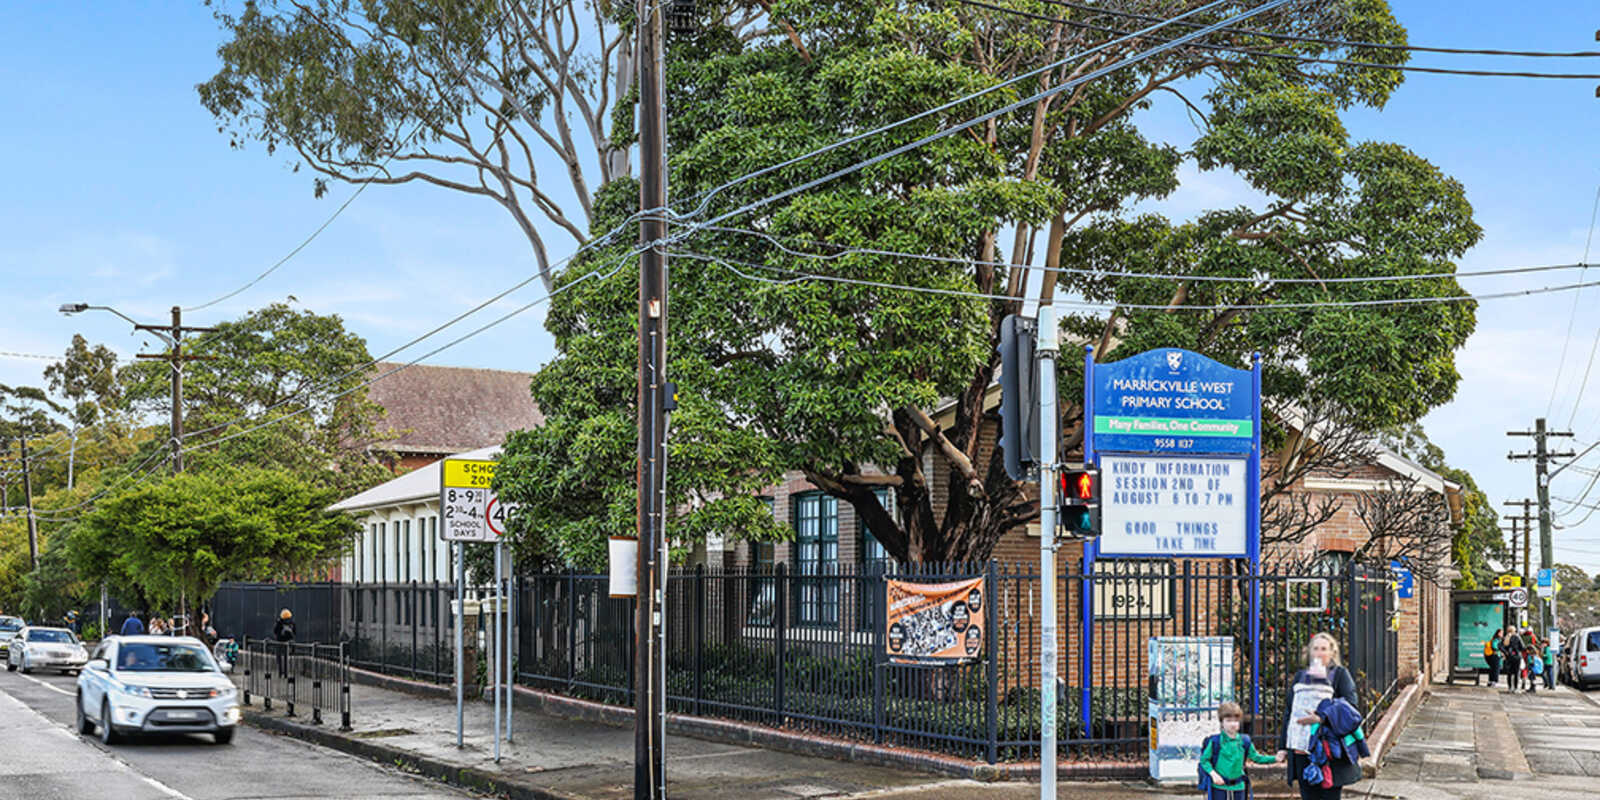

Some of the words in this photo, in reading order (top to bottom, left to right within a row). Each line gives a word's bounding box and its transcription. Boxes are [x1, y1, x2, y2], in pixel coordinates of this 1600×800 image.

[1113, 379, 1198, 393] MARRICKVILLE
[1200, 381, 1234, 394] WEST
[1122, 396, 1172, 409] PRIMARY
[1175, 398, 1225, 410] SCHOOL
[1109, 419, 1132, 432] Many
[1133, 419, 1169, 432] Families,
[1170, 421, 1188, 431] One
[1190, 421, 1240, 434] Community
[1154, 438, 1175, 448] 9558
[1178, 439, 1194, 449] 1137
[463, 464, 494, 474] SCHO
[1112, 462, 1145, 475] KINDY
[1156, 462, 1230, 476] INFORMATION
[1115, 477, 1168, 490] SESSION
[1171, 478, 1194, 490] 2ND
[1207, 478, 1221, 491] OF
[1113, 492, 1159, 505] AUGUST
[1173, 493, 1179, 504] 6
[1185, 493, 1199, 505] TO
[1204, 493, 1211, 505] 7
[1218, 493, 1233, 506] PM
[450, 520, 481, 529] SCHOOL
[1125, 521, 1157, 535] GOOD
[1176, 522, 1218, 535] THINGS
[454, 529, 477, 537] DAYS
[1155, 537, 1183, 550] TAKE
[1193, 537, 1216, 550] TIME
